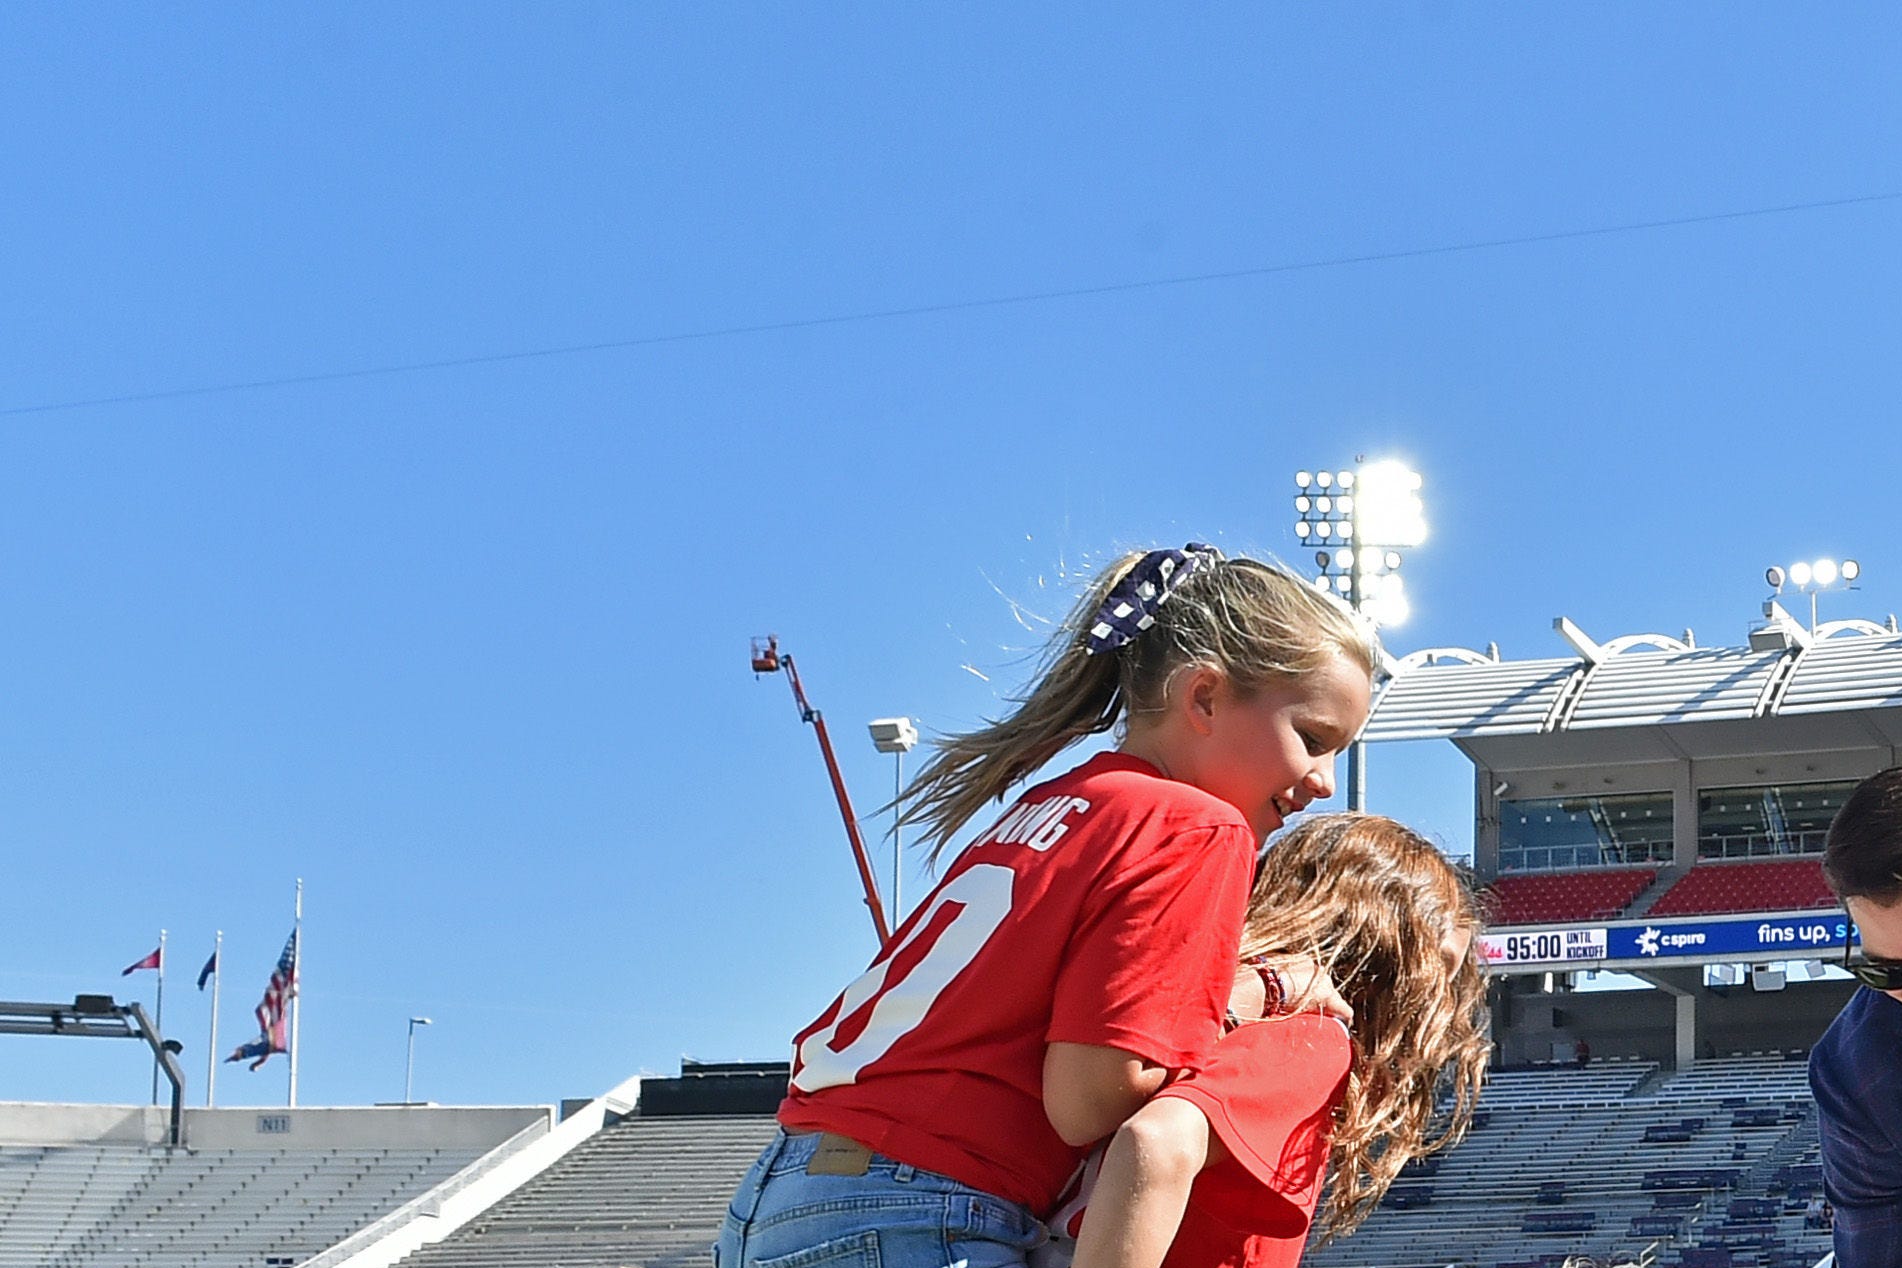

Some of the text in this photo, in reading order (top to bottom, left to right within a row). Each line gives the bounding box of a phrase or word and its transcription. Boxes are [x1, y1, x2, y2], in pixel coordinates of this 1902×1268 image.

[1566, 931, 1592, 945] UNTIL
[1757, 924, 1795, 943] fins
[1799, 924, 1831, 945] up,
[1506, 934, 1561, 961] 95:00
[1566, 945, 1604, 959] KICKOFF
